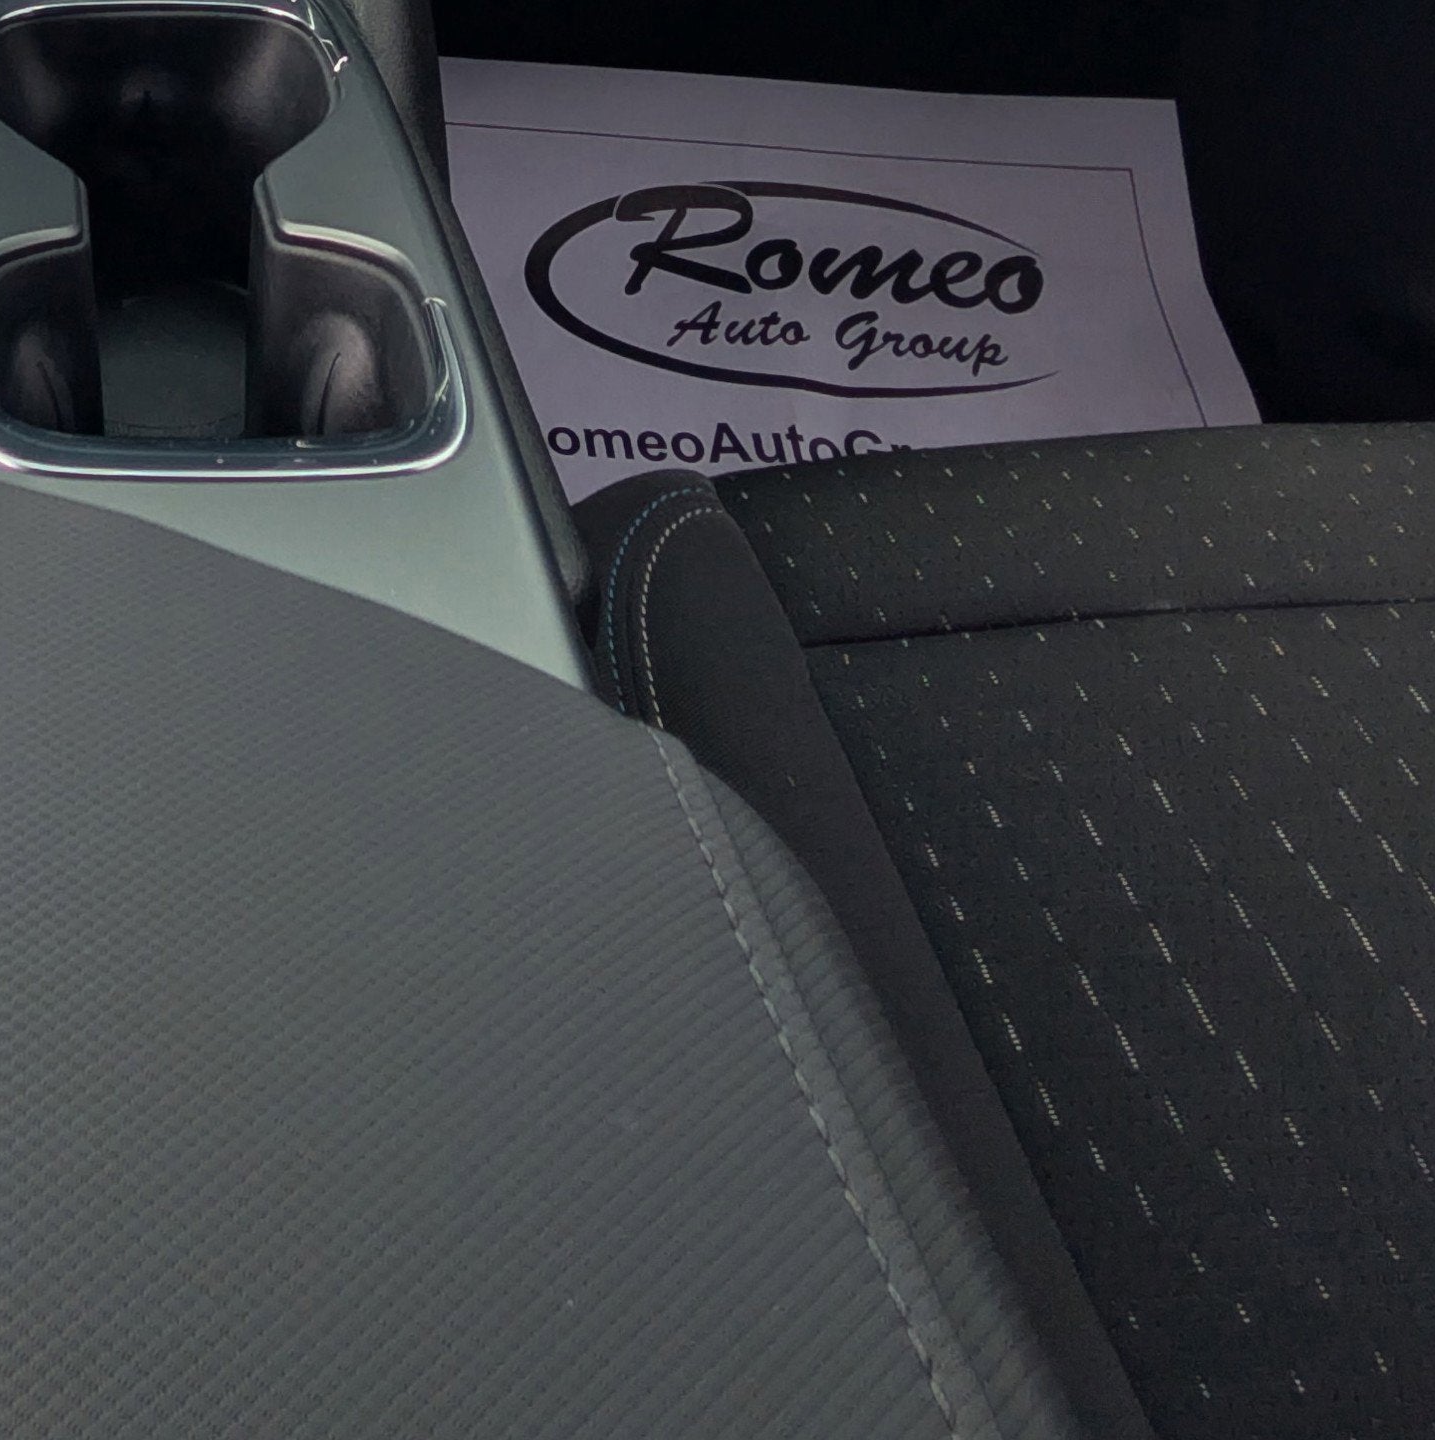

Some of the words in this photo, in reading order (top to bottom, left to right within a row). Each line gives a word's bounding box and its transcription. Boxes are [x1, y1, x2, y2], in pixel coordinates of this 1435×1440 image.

[612, 185, 1044, 317] Romeo
[667, 300, 811, 349] Auto
[836, 311, 1009, 373] Group
